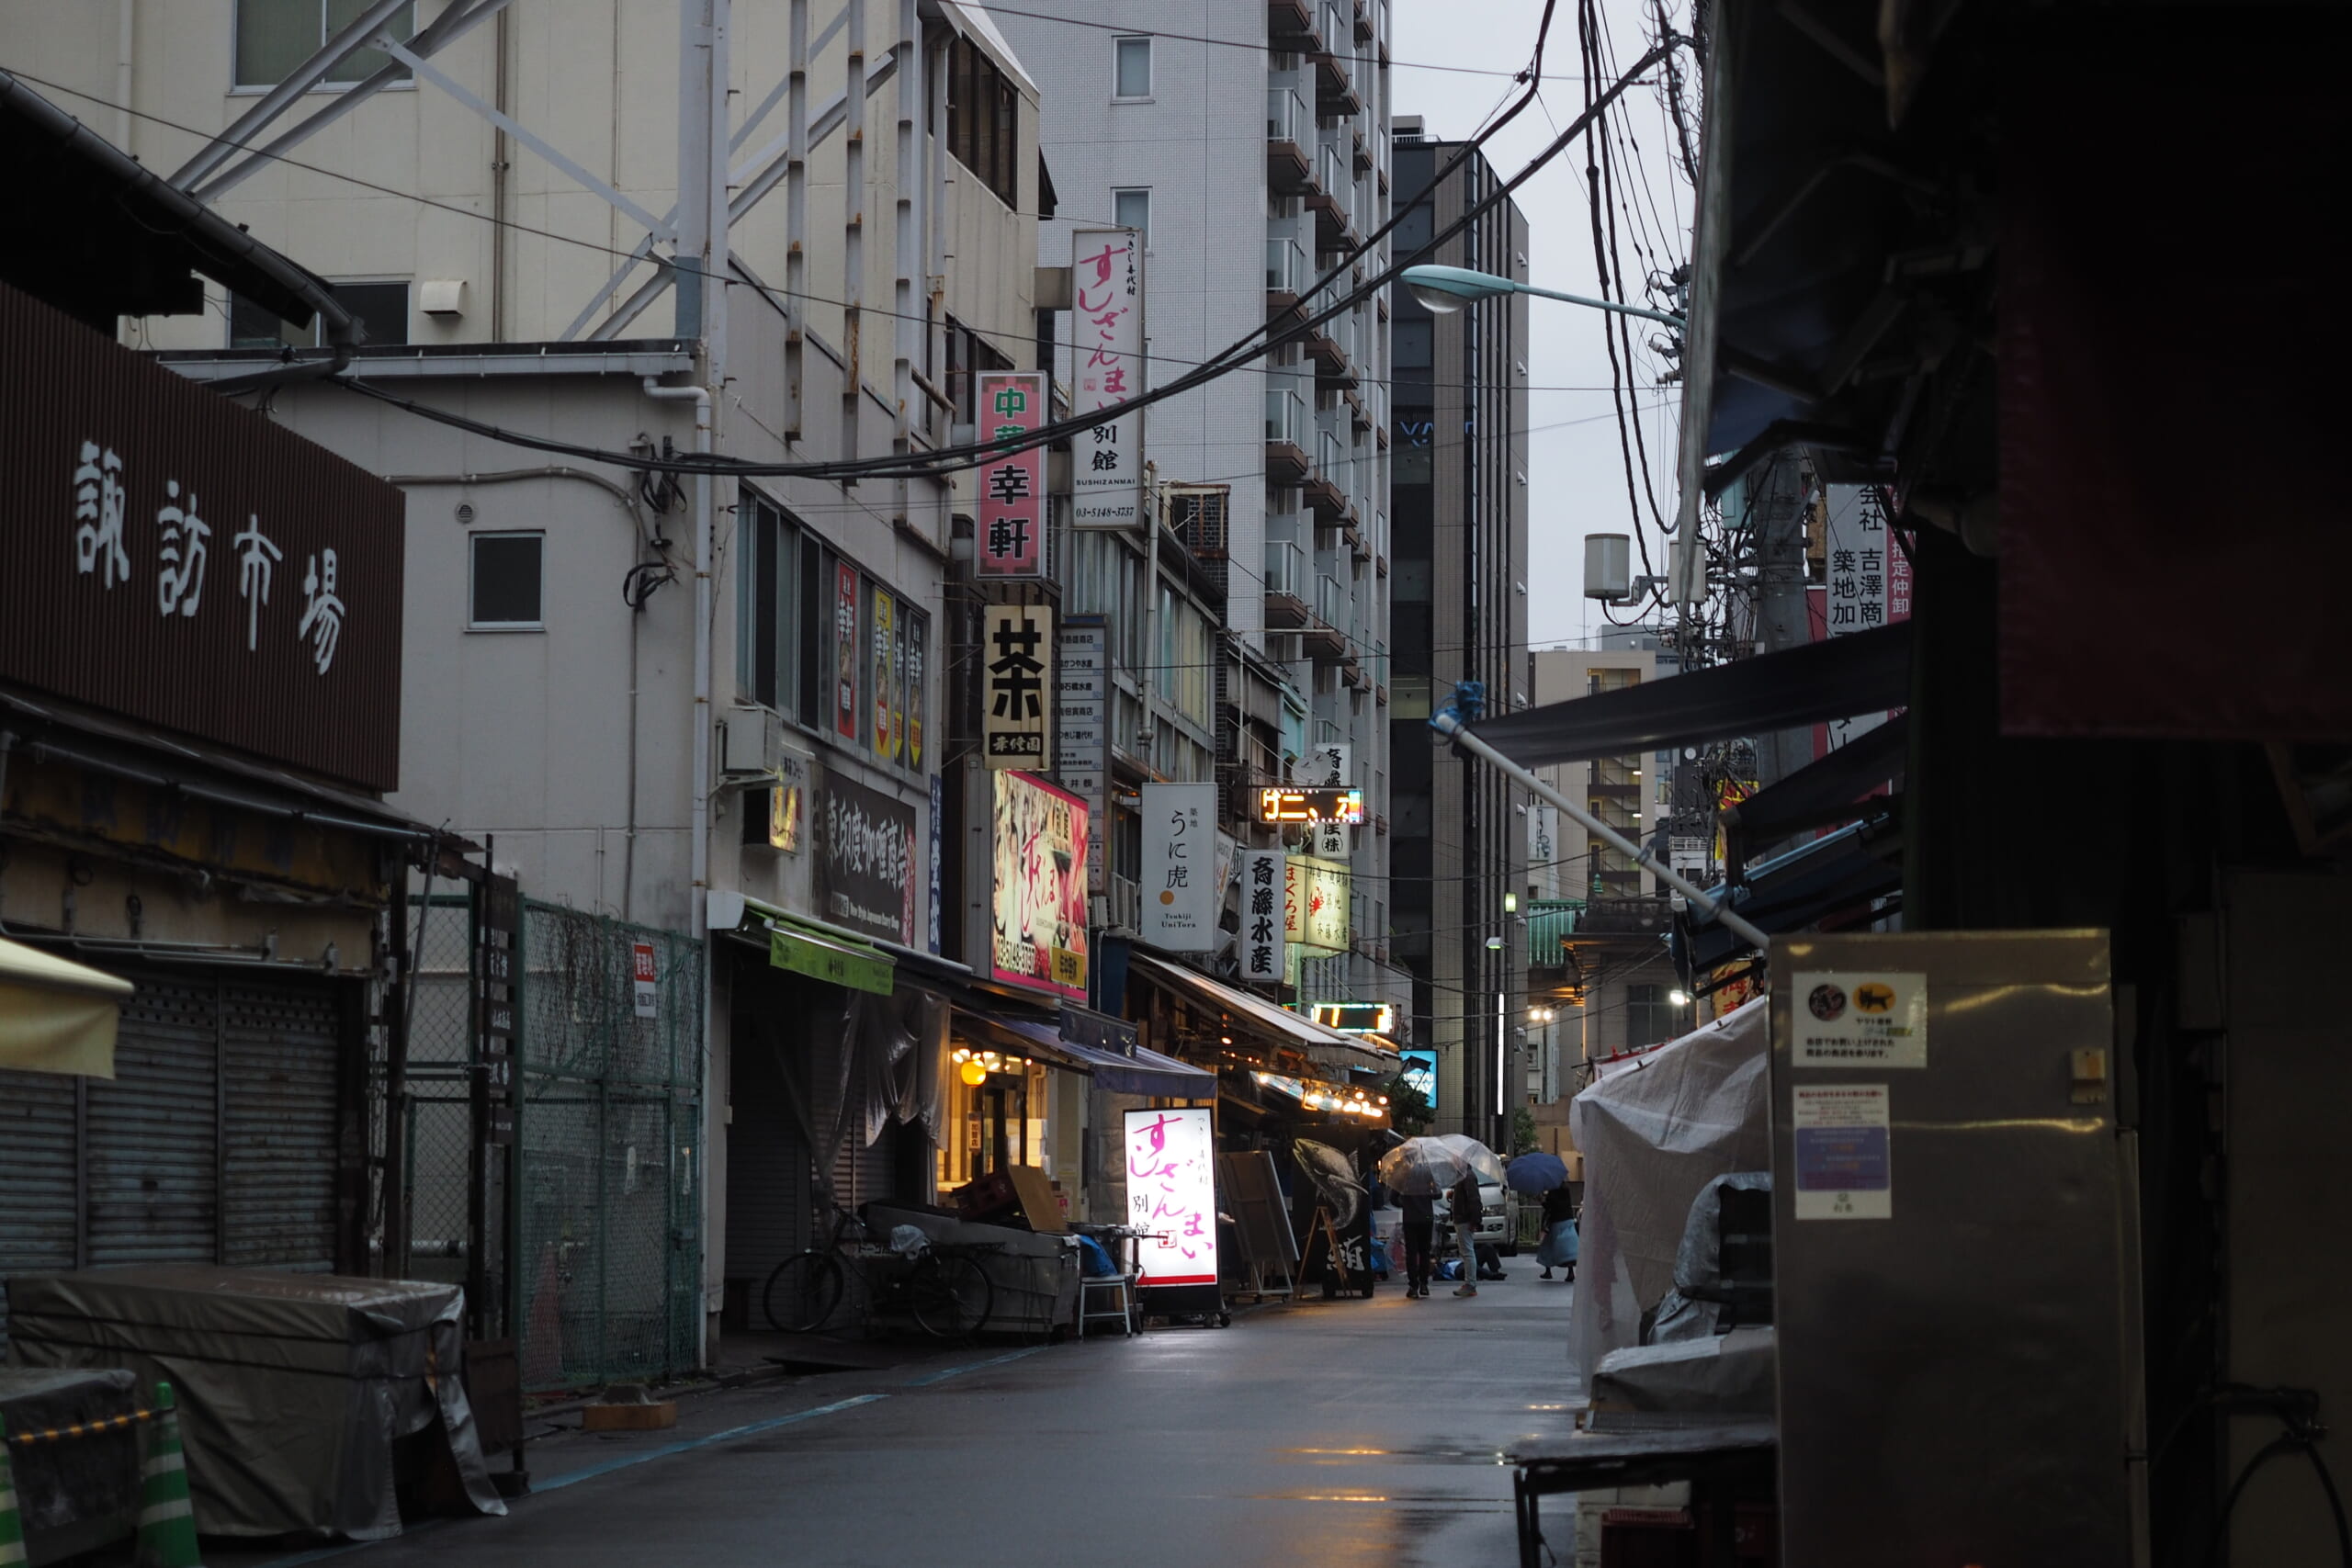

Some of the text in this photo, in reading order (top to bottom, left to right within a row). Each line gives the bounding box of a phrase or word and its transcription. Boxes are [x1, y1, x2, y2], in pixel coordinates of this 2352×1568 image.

[1079, 243, 1129, 412] すしざんまい
[1076, 478, 1136, 487] SUSHIZANMAI
[1091, 425, 1120, 471] 別館
[1076, 505, 1135, 519] 03-5148-3737
[74, 440, 345, 675] 諏訪市場
[988, 619, 1046, 721] 茶
[1166, 810, 1188, 889] うに虎
[1130, 1113, 1213, 1259] すしざんまい
